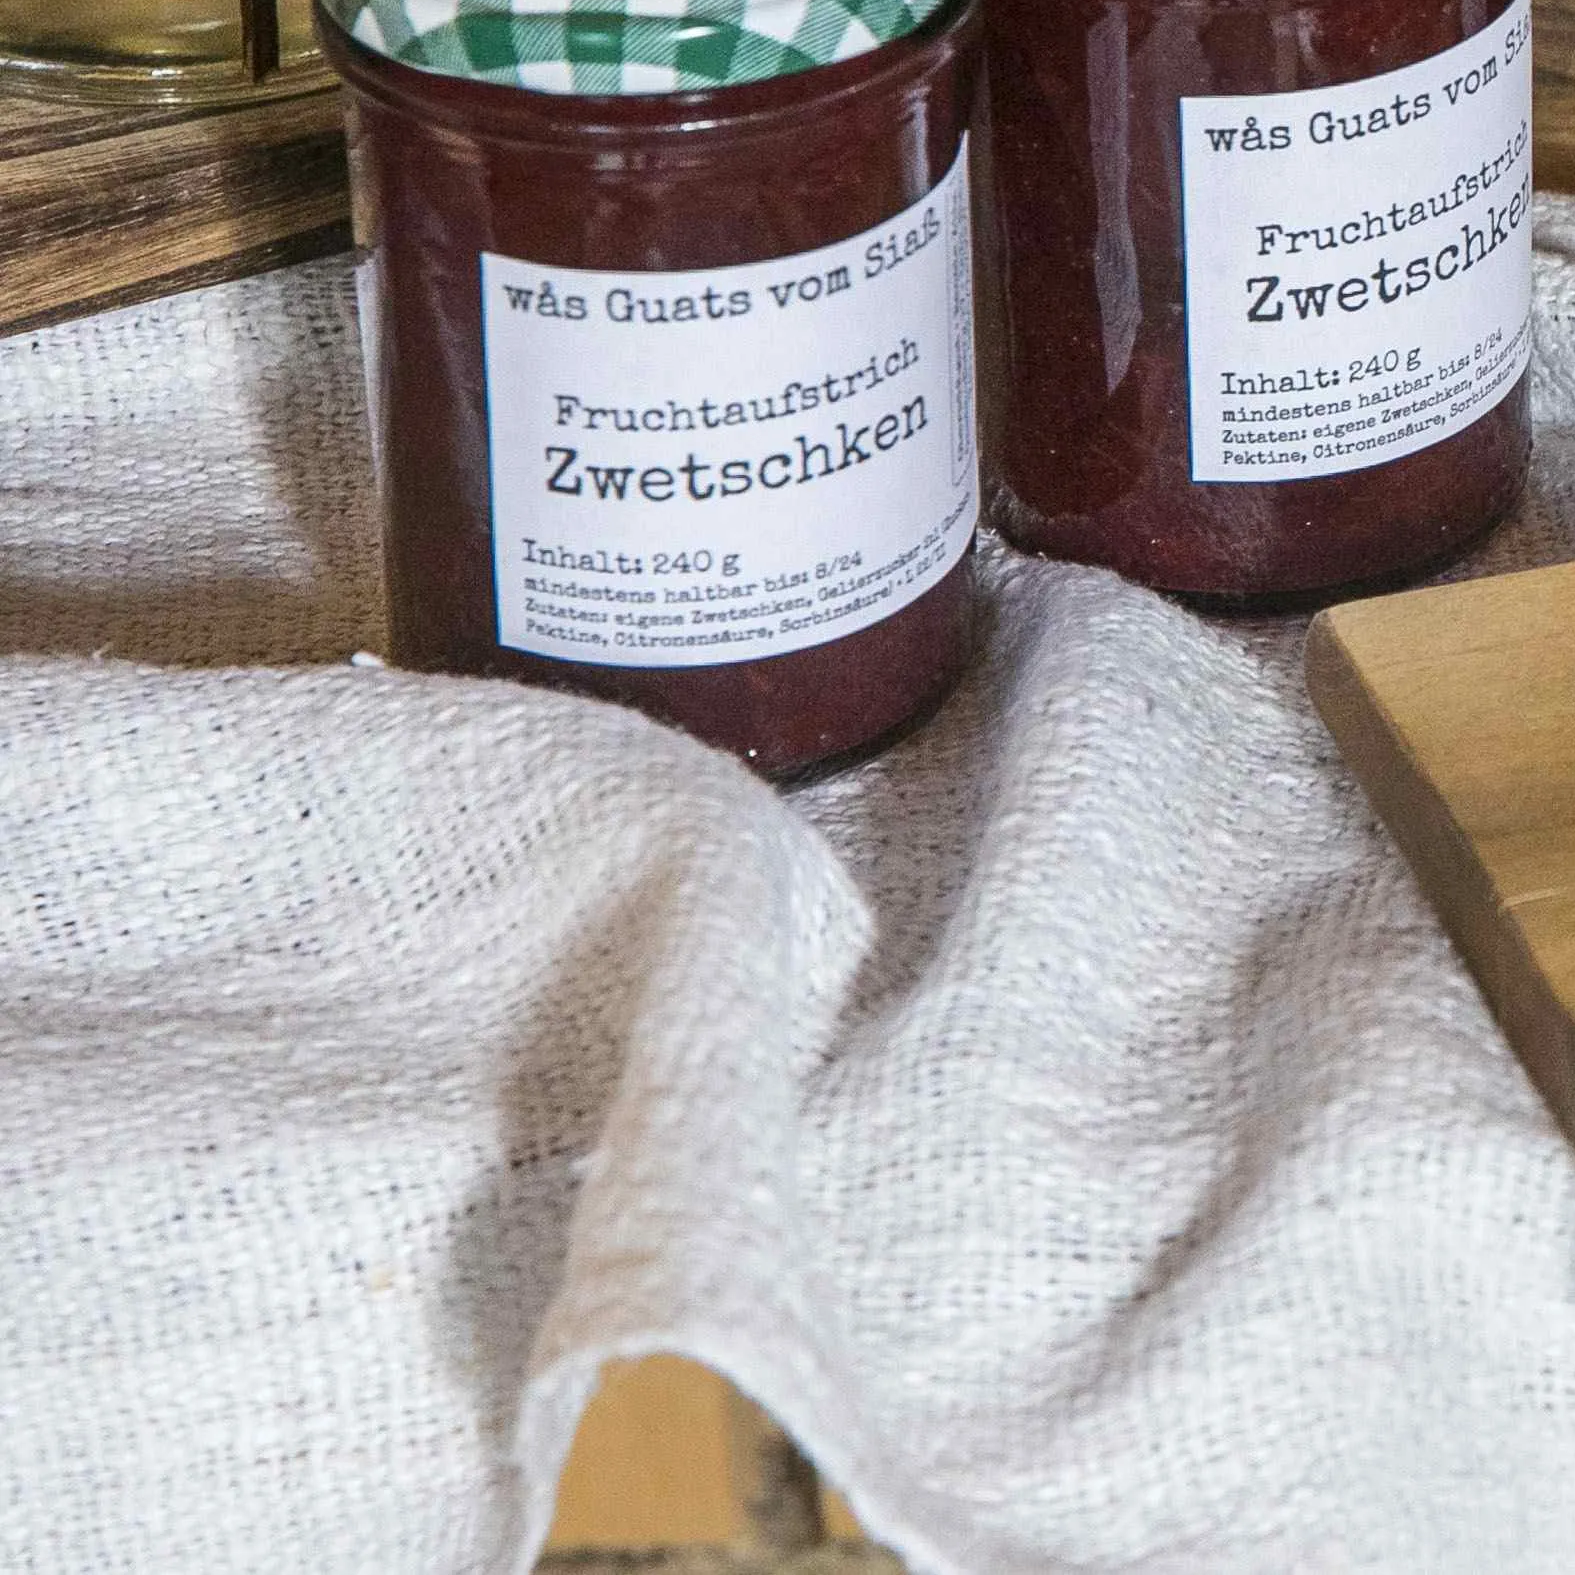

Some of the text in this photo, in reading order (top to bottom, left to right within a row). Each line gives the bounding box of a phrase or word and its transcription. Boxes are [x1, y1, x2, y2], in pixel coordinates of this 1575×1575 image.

[1205, 116, 1291, 151] wås
[1309, 92, 1431, 144] Guats
[1443, 56, 1498, 106] vom
[503, 206, 940, 324] wås Guats vom Siaß
[554, 336, 920, 434] Fruchtaufstrich
[1221, 347, 1421, 395] Inhalt: 240 g
[1222, 399, 1351, 422] mindestens
[1358, 374, 1434, 409] haltbar
[1438, 354, 1471, 381] bis:
[1474, 326, 1503, 361] 8/24
[545, 395, 929, 502] Zwetschken
[1222, 429, 1307, 444] Zutaten:
[1313, 417, 1376, 439] eigene
[1380, 380, 1473, 424] Zwetschken,
[1223, 450, 1307, 465] Pektine,
[1313, 414, 1447, 458] Citronensäure,
[522, 537, 740, 576] Inhalt: 240 g
[524, 550, 864, 604] mindestens haltbar bis: 8/24
